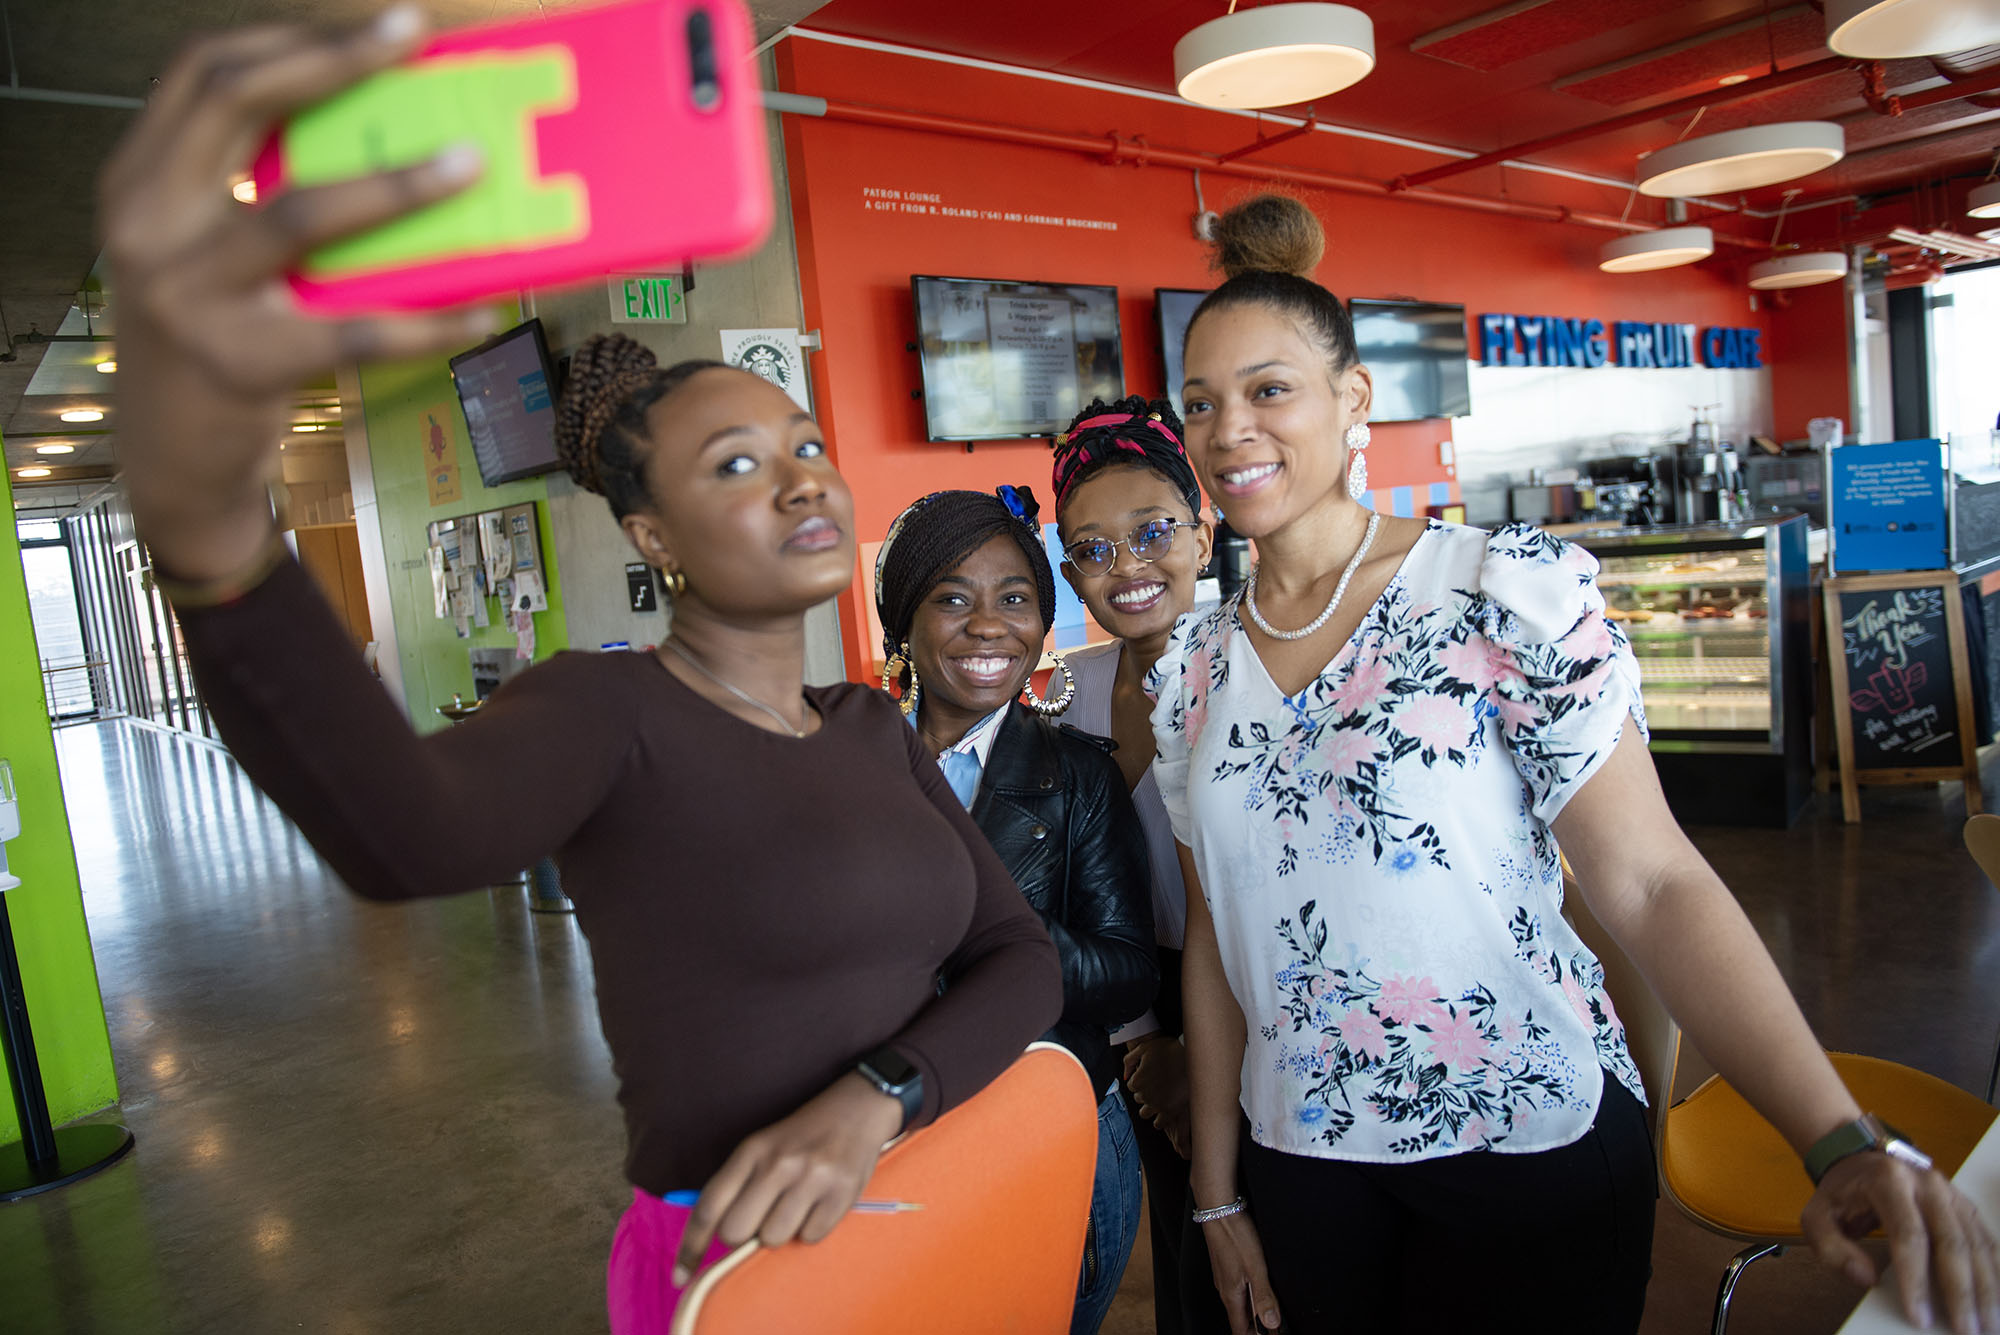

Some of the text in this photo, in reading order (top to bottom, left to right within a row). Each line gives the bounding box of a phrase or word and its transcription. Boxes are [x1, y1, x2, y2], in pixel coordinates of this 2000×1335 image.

[863, 187, 941, 203] PATRON LOUNGE
[864, 200, 872, 209] A
[874, 201, 897, 211] GIFT
[900, 203, 926, 214] FROM
[941, 207, 979, 219] ROLAND
[1004, 212, 1022, 222] AND
[1024, 214, 1064, 226] LORRAINE
[623, 279, 672, 319] EXIT
[1478, 313, 1609, 368] FLYING
[1613, 320, 1696, 368] FRUIT
[1842, 591, 1927, 641] Thank
[1876, 621, 1925, 669] You
